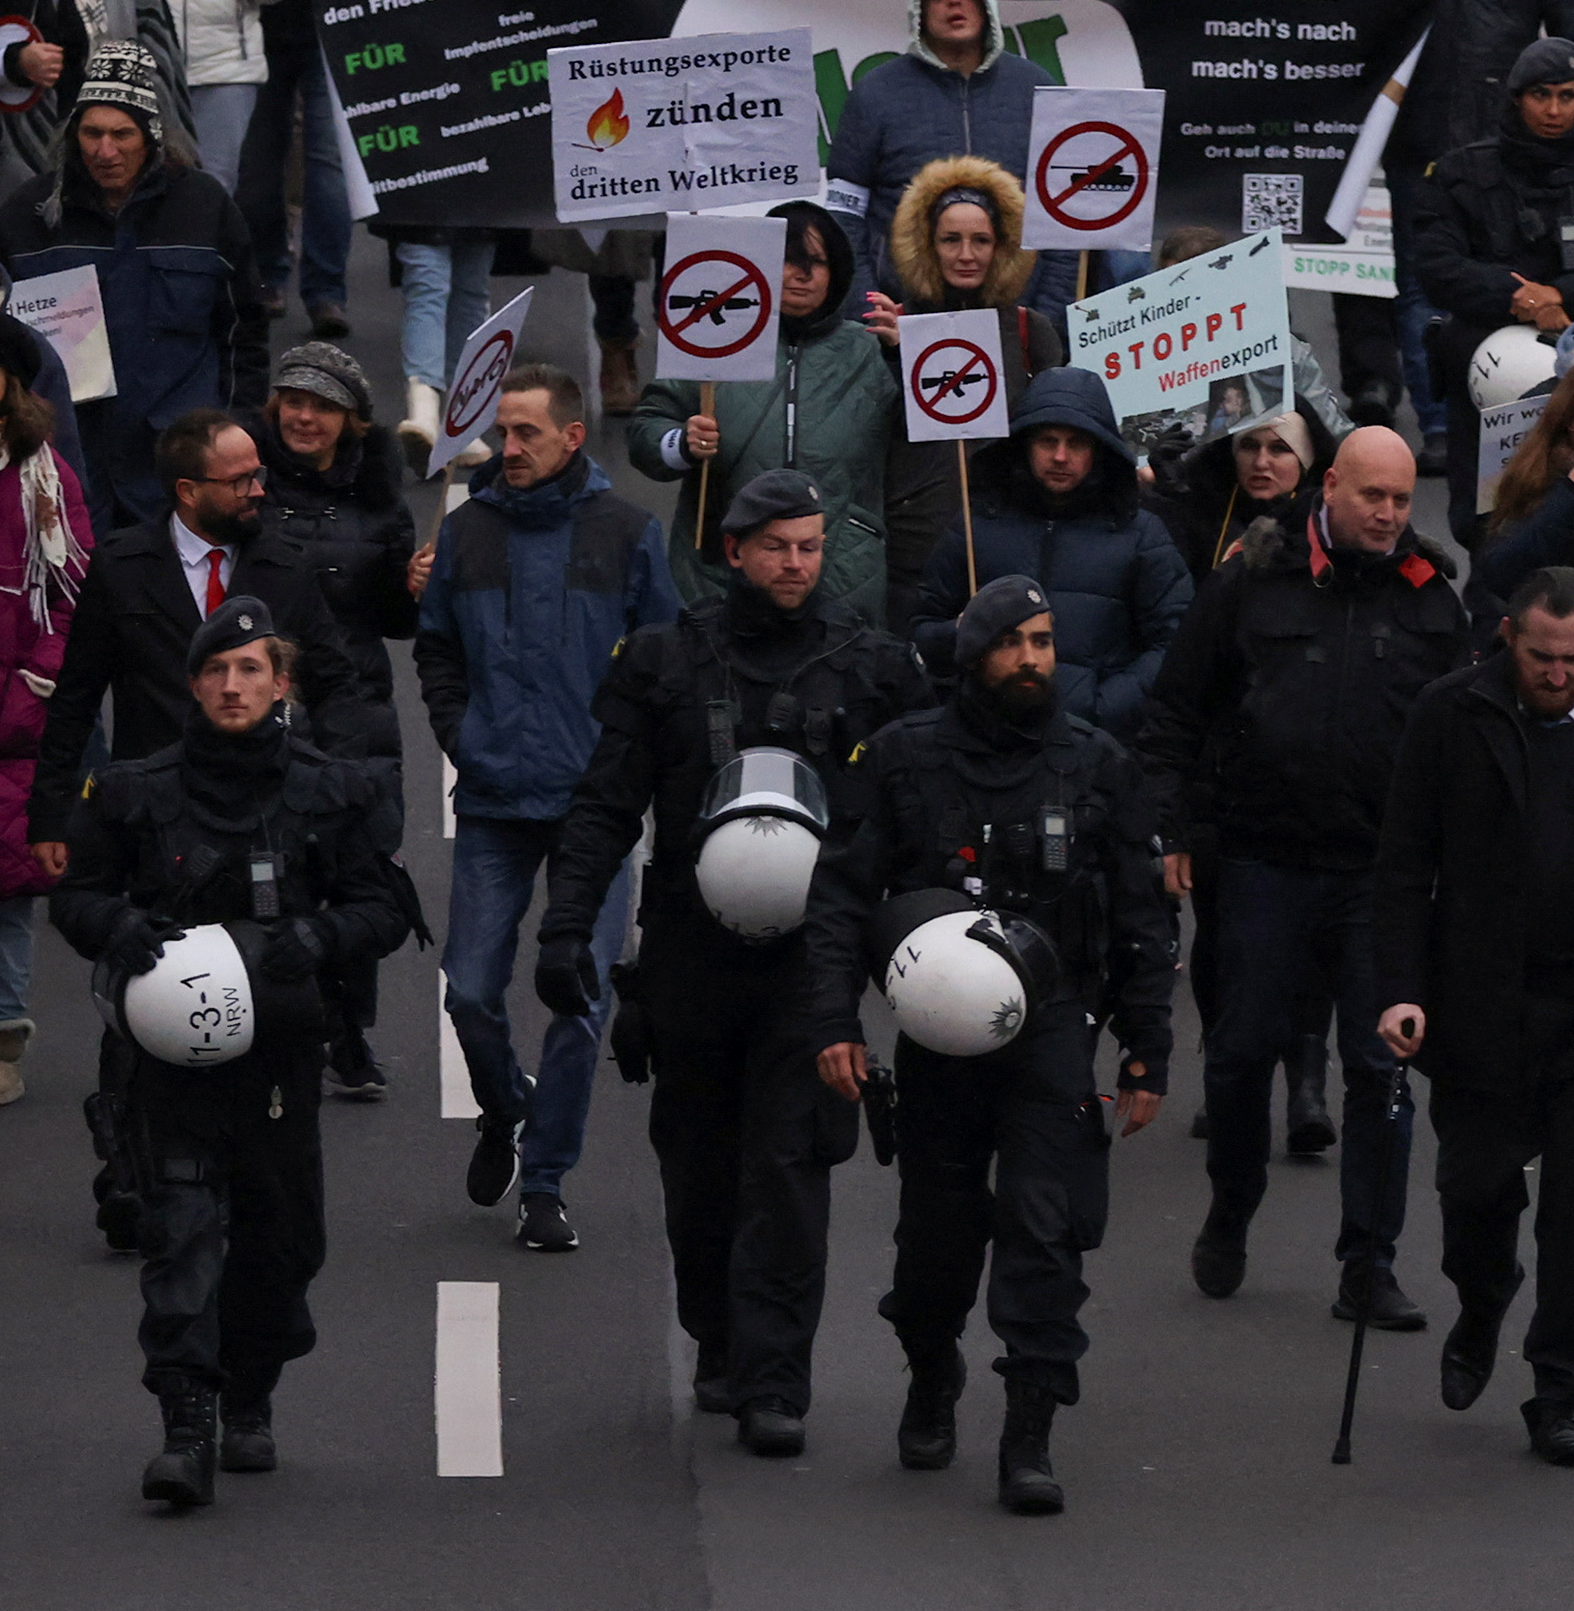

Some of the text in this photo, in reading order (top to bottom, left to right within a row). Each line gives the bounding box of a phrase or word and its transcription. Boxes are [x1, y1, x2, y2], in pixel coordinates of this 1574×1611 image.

[323, 3, 364, 25] den
[498, 10, 535, 27] freie
[444, 18, 598, 60] Impfentscheidungen
[1204, 18, 1357, 41] mach's nach
[344, 43, 407, 75] FÜR
[568, 45, 792, 80] Rüstungsexporte
[1191, 59, 1365, 81] mach's besser
[490, 59, 549, 92] FÜR
[399, 82, 461, 106] Energie
[440, 110, 521, 138] bezahlbare
[646, 93, 784, 128] zünden
[357, 125, 420, 158] FÜR
[1180, 122, 1213, 135] Geh
[1217, 123, 1256, 135] auch
[1293, 121, 1309, 133] in
[1205, 145, 1346, 159] Ort auf die Straße
[371, 157, 489, 195] itbestimmung
[570, 164, 598, 178] den
[571, 161, 799, 200] dritten Weltkrieg
[1294, 257, 1351, 275] STOPP
[17, 297, 57, 315] Hetze
[1079, 315, 1136, 348] Schützt
[1141, 295, 1190, 324] Kinder
[1105, 302, 1247, 380] STOPPT
[1158, 334, 1279, 392] Waffenexport
[1484, 413, 1511, 428] Wir
[222, 988, 241, 1036] NRW
